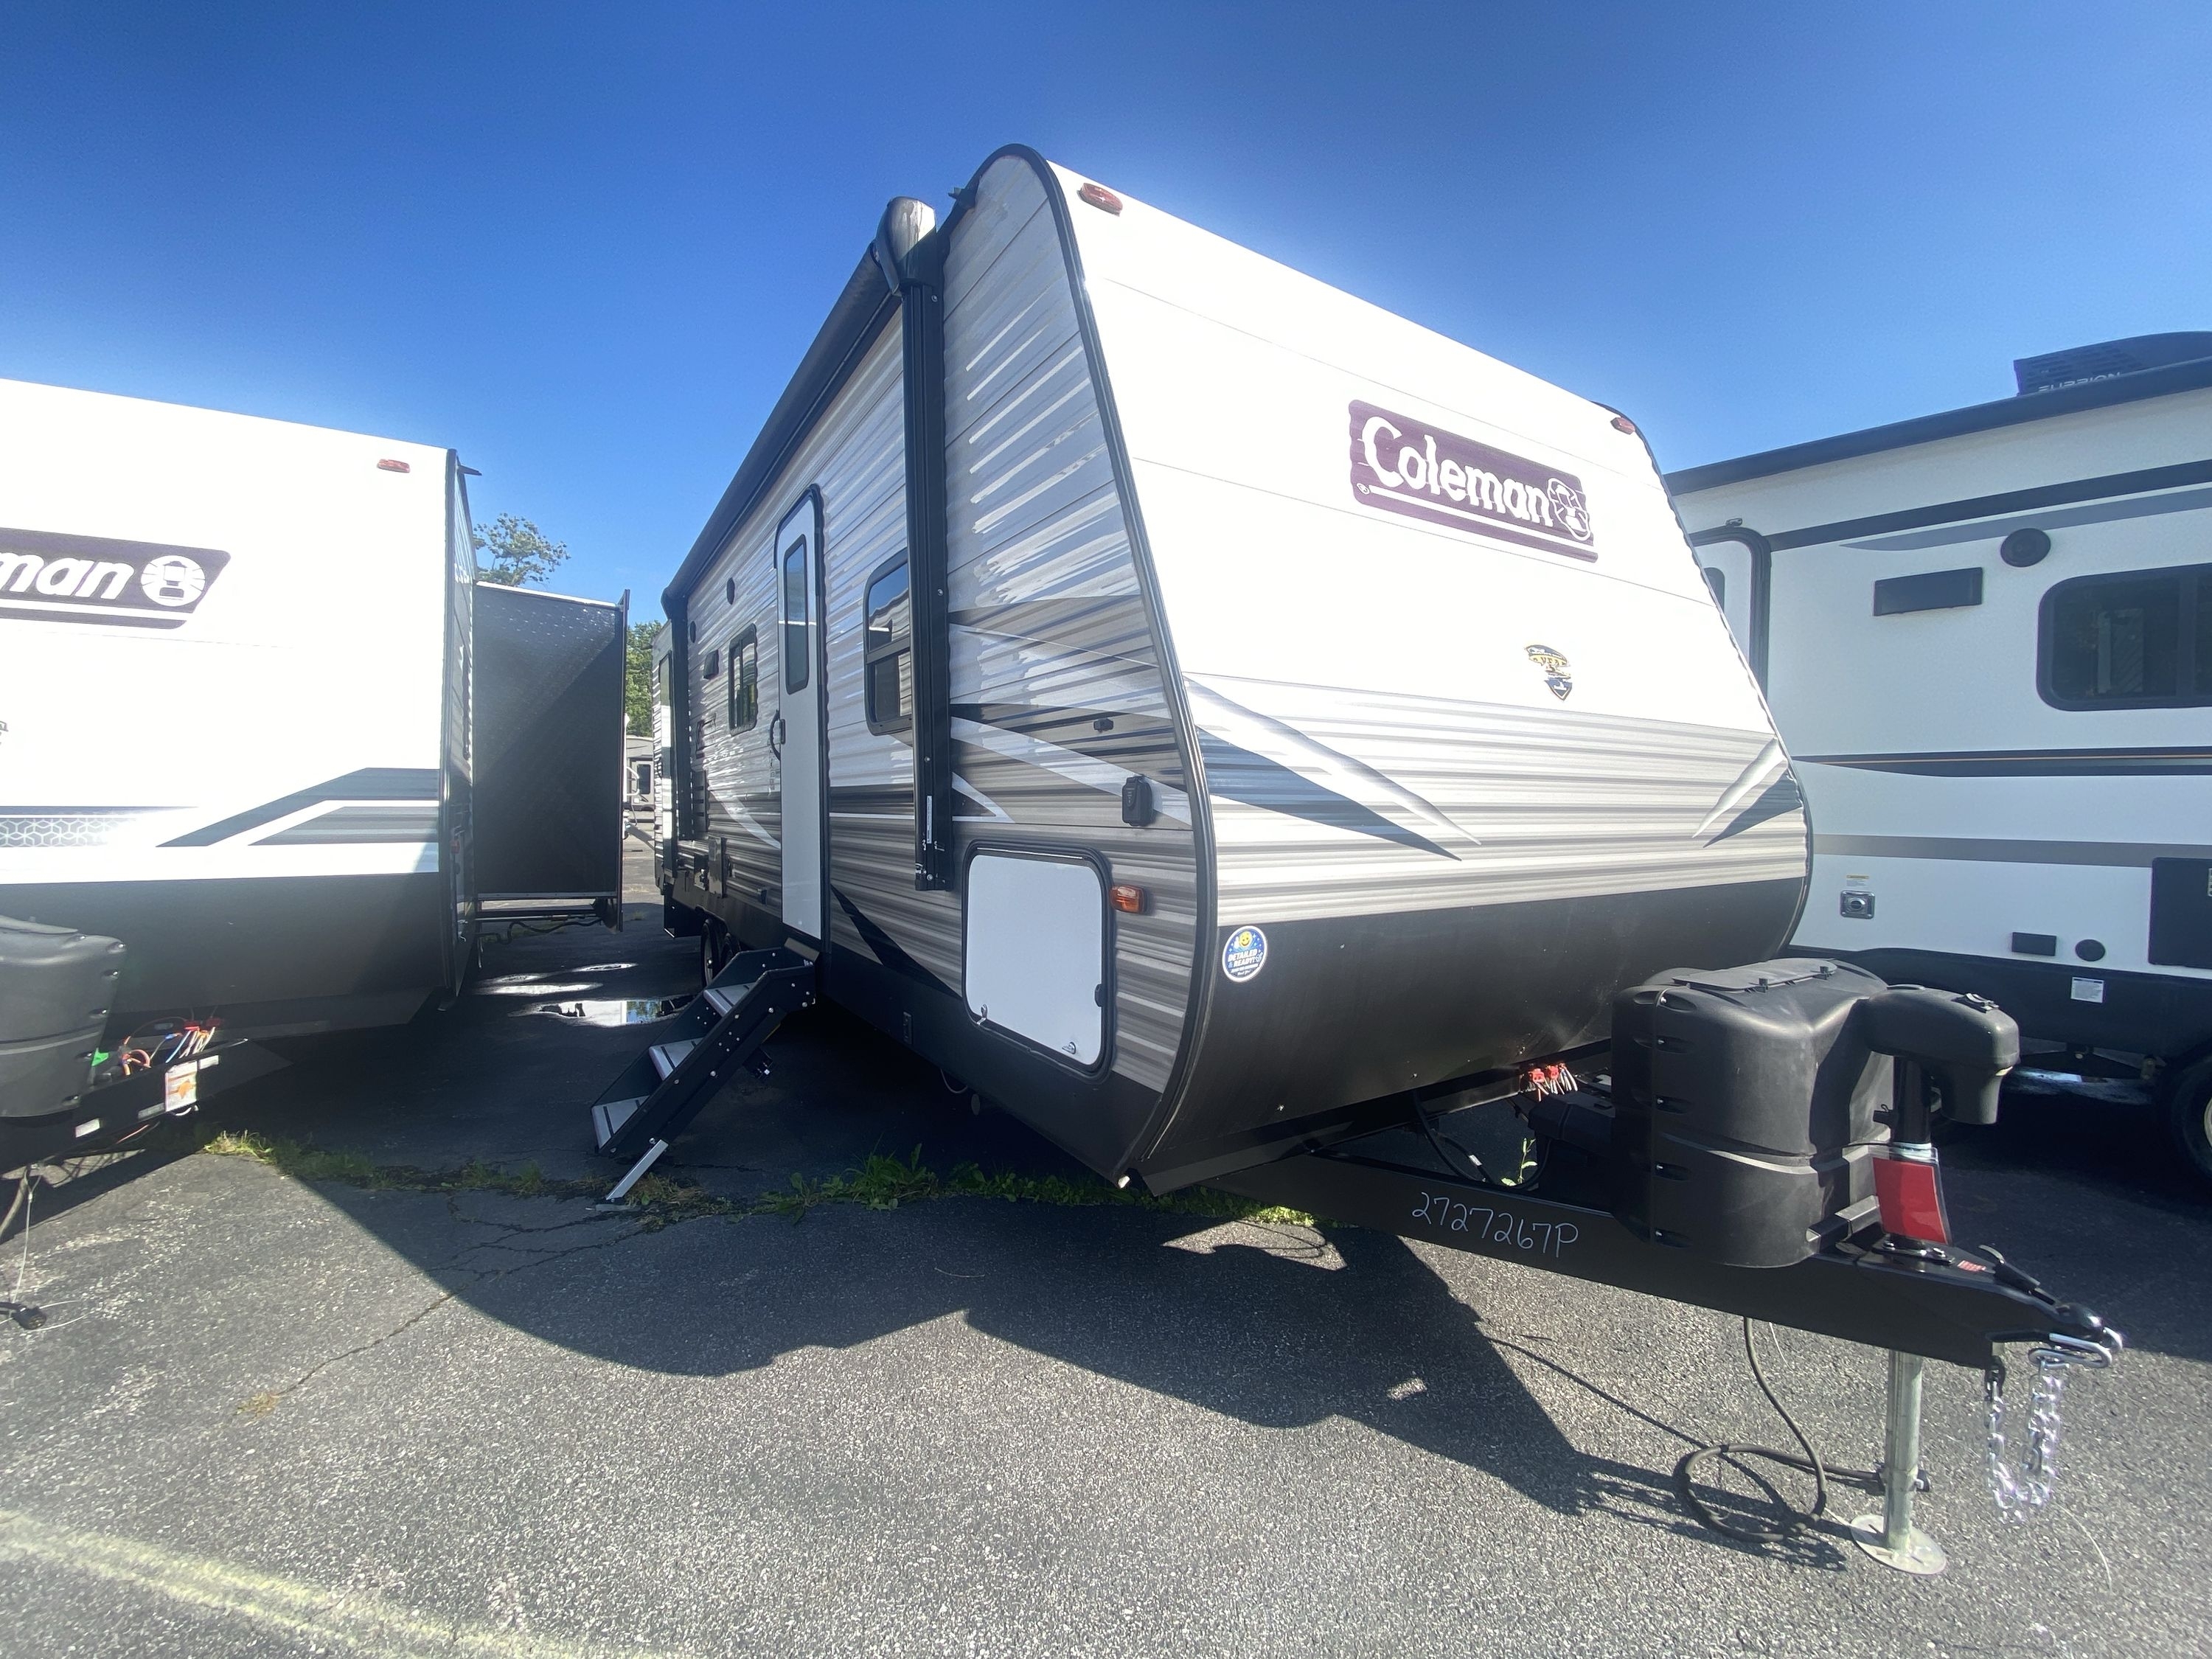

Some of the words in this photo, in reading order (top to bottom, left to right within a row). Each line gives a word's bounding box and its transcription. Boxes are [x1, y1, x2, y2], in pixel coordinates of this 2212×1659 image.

[1362, 416, 1554, 527] Coleman
[1227, 948, 1258, 962] DETAILED
[1411, 1192, 1579, 1258] 2727267P
